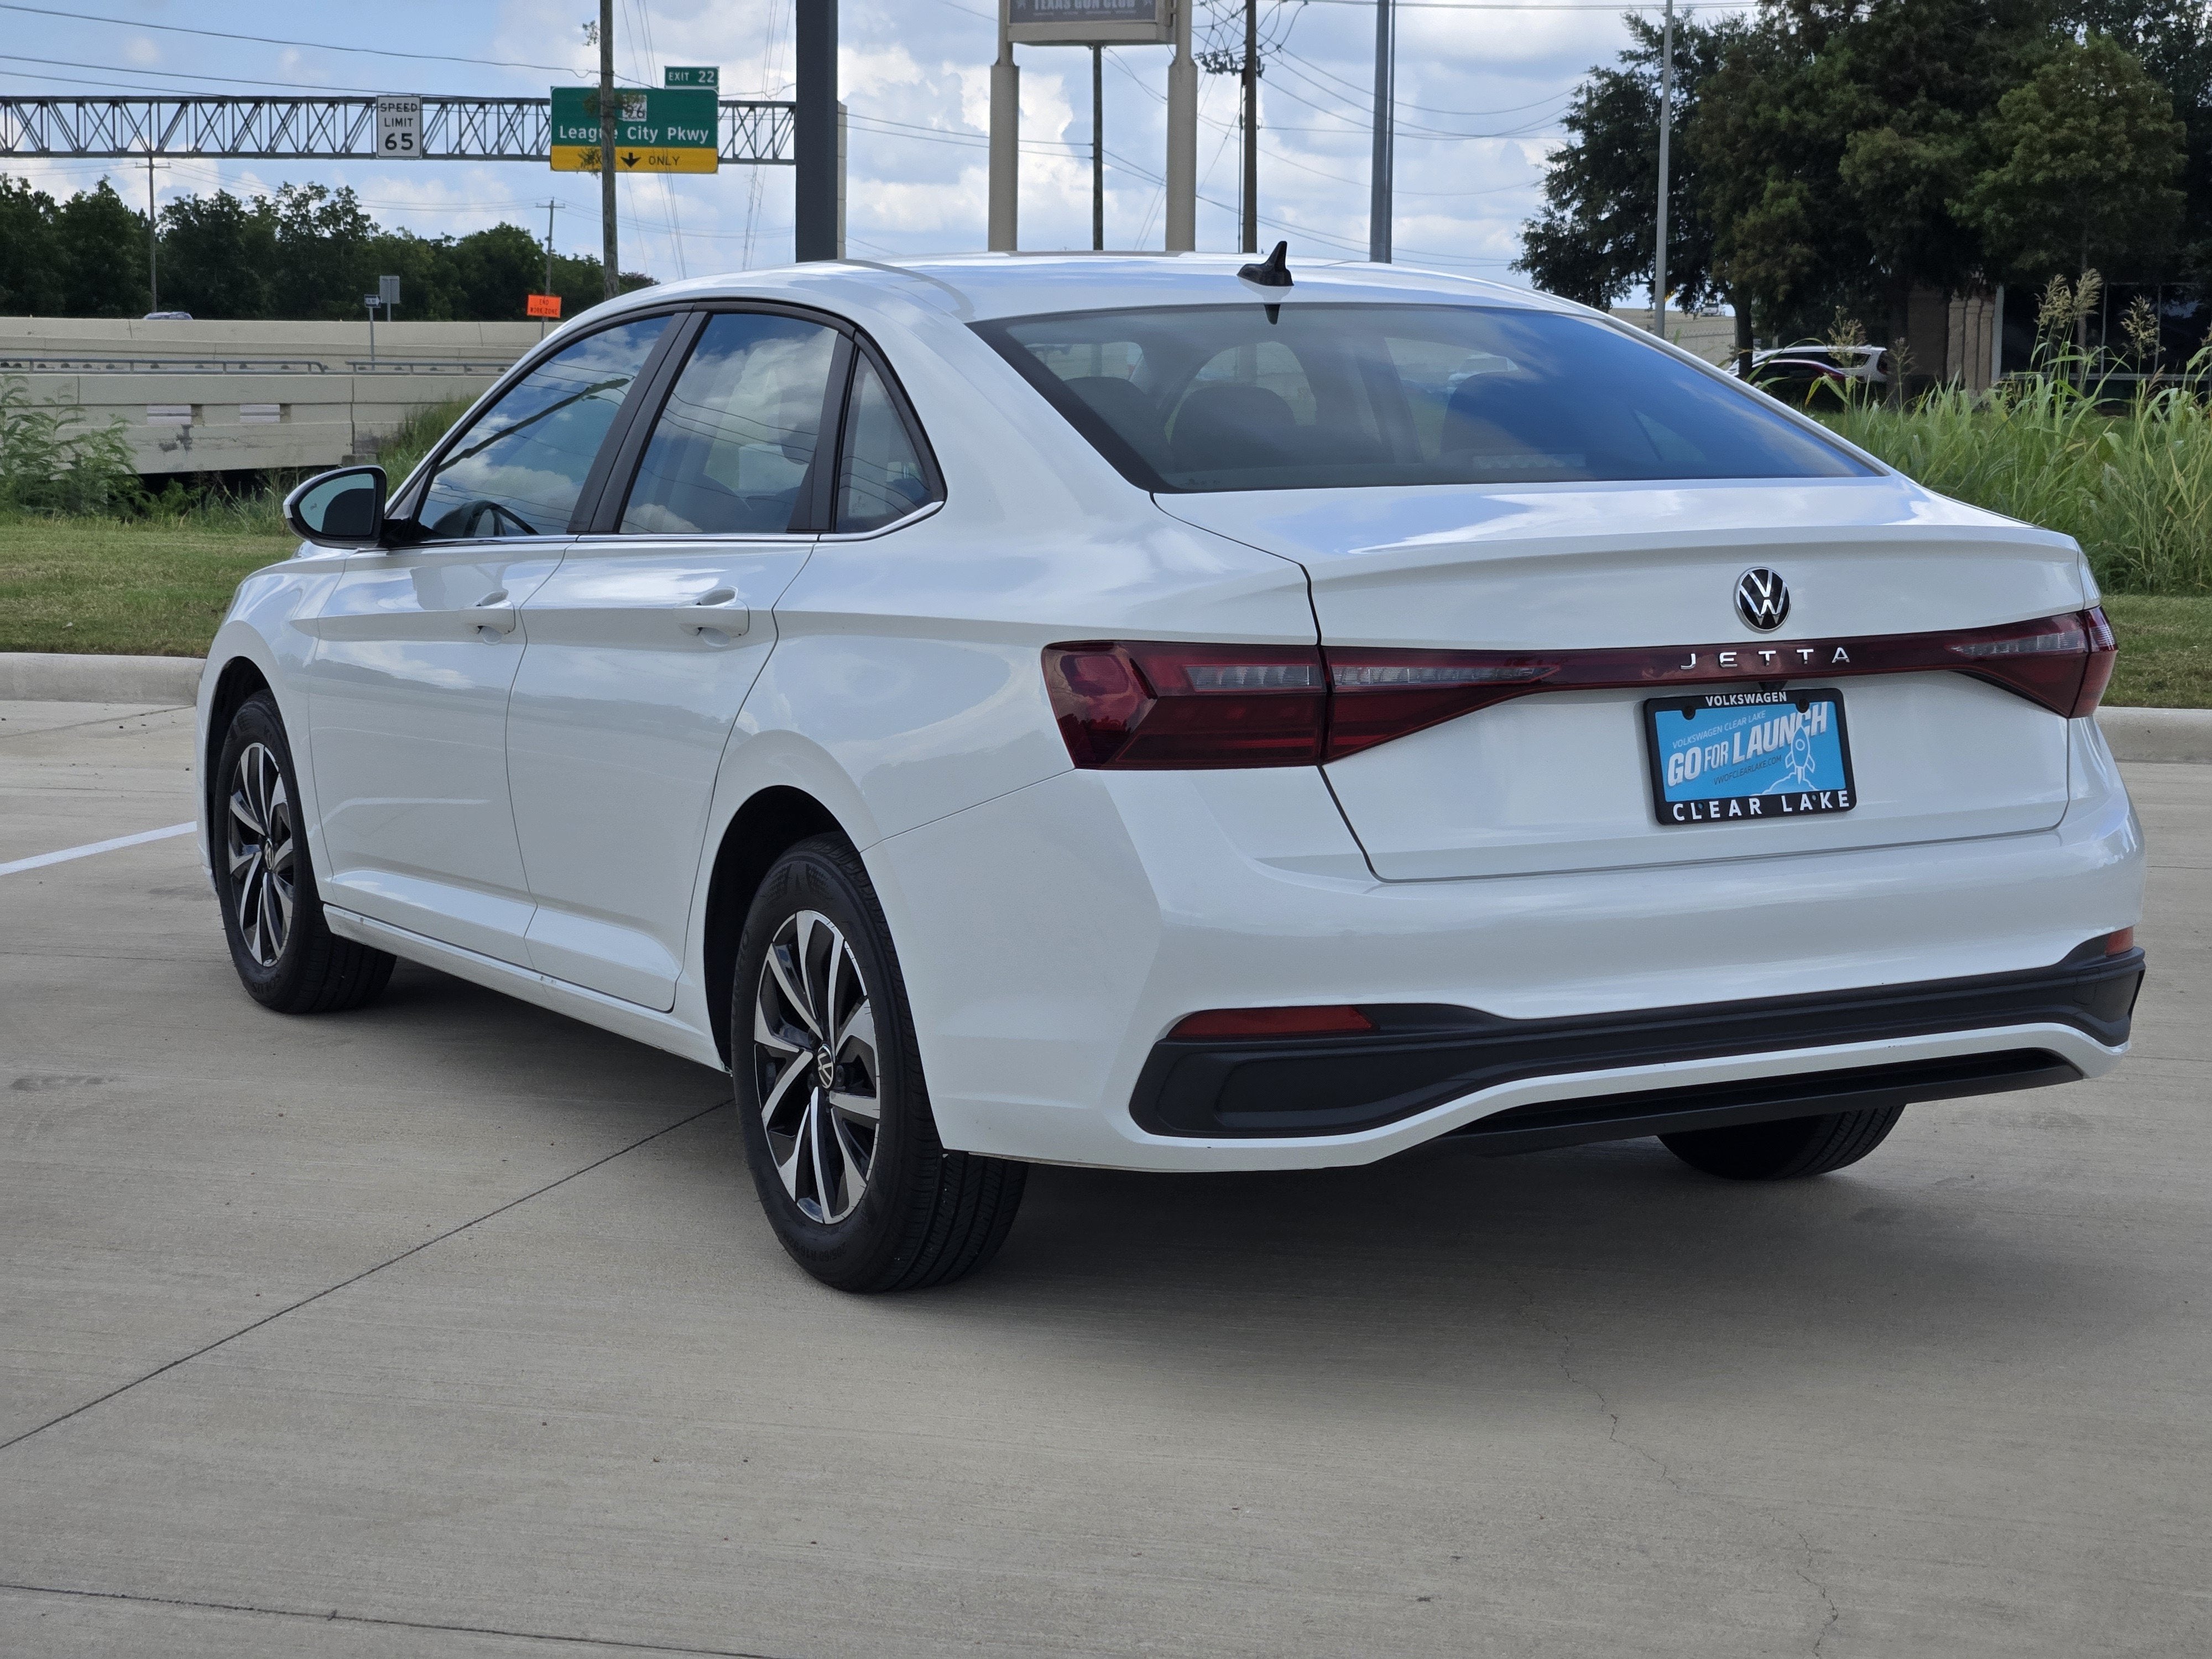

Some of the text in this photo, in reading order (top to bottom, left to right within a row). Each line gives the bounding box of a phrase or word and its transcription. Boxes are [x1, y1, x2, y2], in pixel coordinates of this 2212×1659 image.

[668, 70, 714, 83] EXIT 22
[380, 103, 418, 112] SPEED
[384, 118, 414, 127] LIMIT
[385, 133, 413, 150] 65
[627, 126, 658, 144] City
[667, 126, 709, 144] Pkwy
[649, 155, 680, 166] ONLY
[545, 307, 558, 315] ZONE
[1680, 646, 1850, 670] JETTA
[1705, 691, 1787, 707] VOLKSWAGEN
[1672, 709, 1766, 749] VOLKSWAGEN CLEAR LAKE
[1667, 701, 1828, 786] GO FOR LAUNCH
[1714, 754, 1782, 785] VWOFCLEARLAKE.COM
[1673, 791, 1850, 821] CLEAR LAKE
